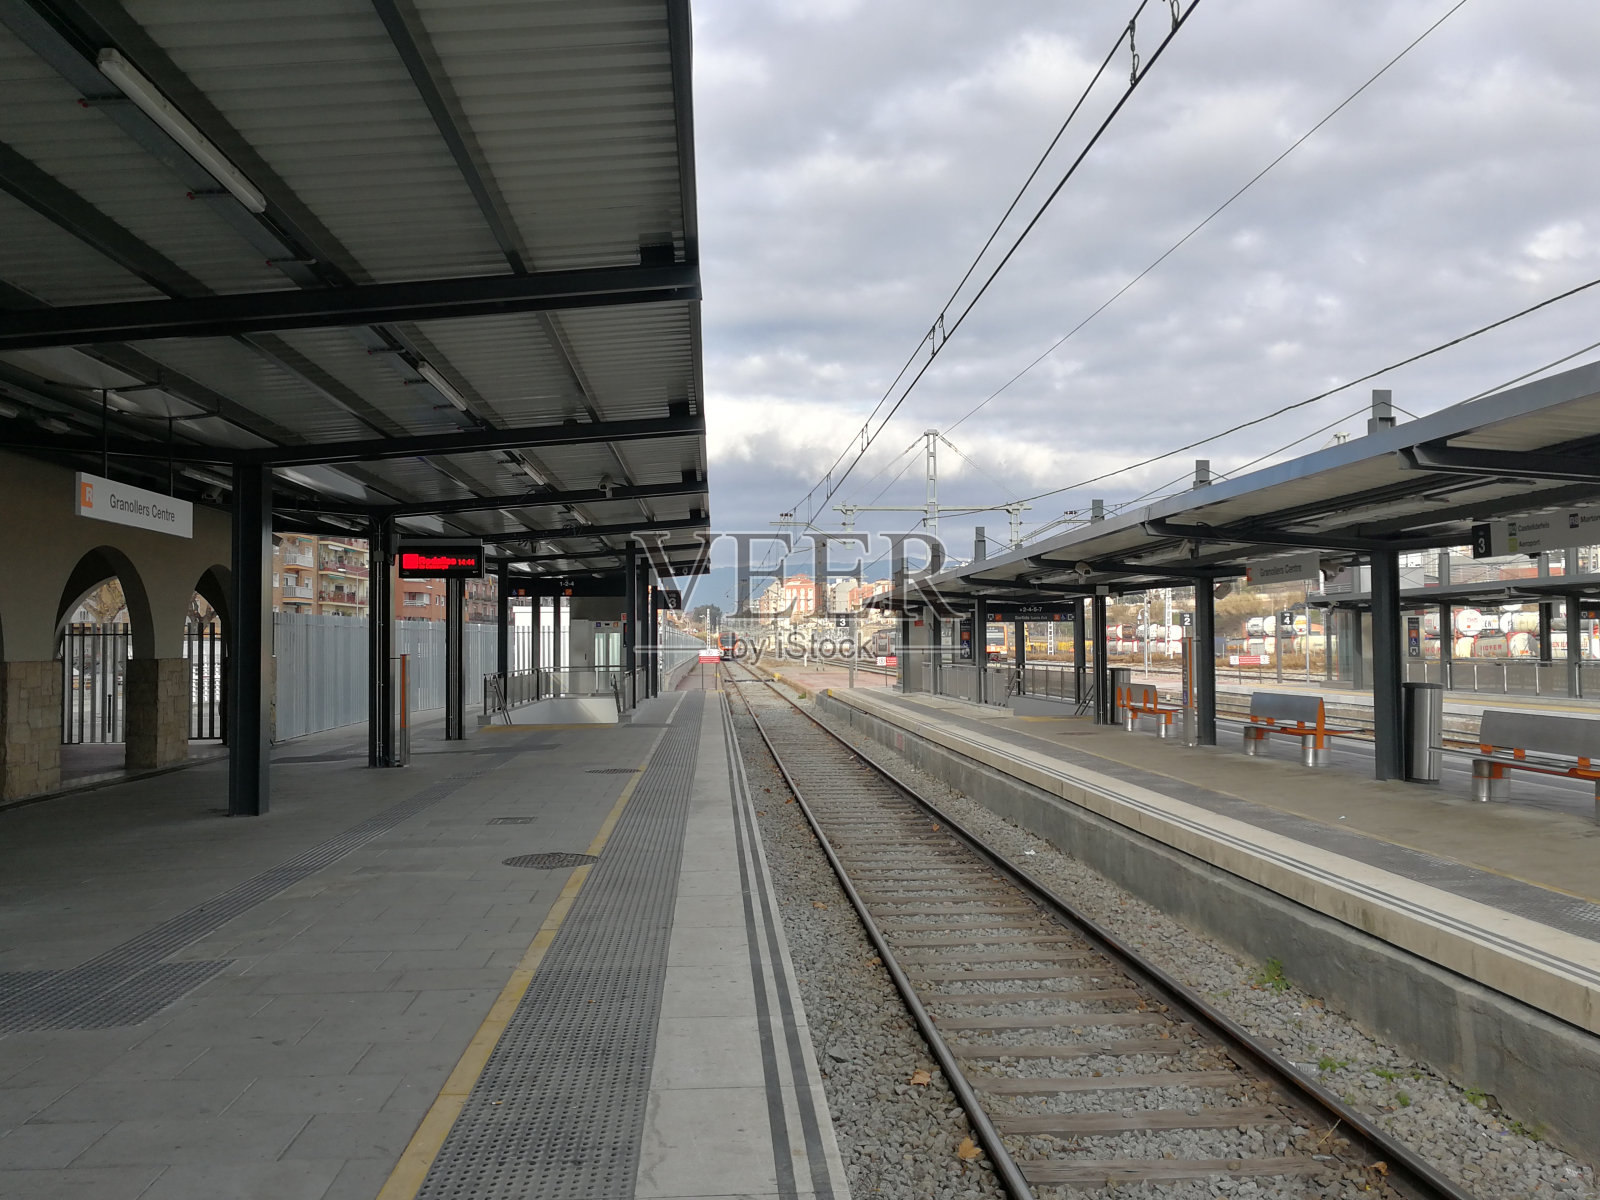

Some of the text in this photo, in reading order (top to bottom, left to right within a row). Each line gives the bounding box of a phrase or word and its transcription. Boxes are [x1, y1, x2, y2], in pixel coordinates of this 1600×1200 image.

[109, 493, 175, 522] Granollers Centre
[1478, 537, 1486, 554] 3
[457, 558, 475, 566] 14:44
[669, 597, 677, 608] 3
[839, 618, 847, 626] 3
[1183, 617, 1191, 626] 2
[1283, 616, 1291, 625] 4
